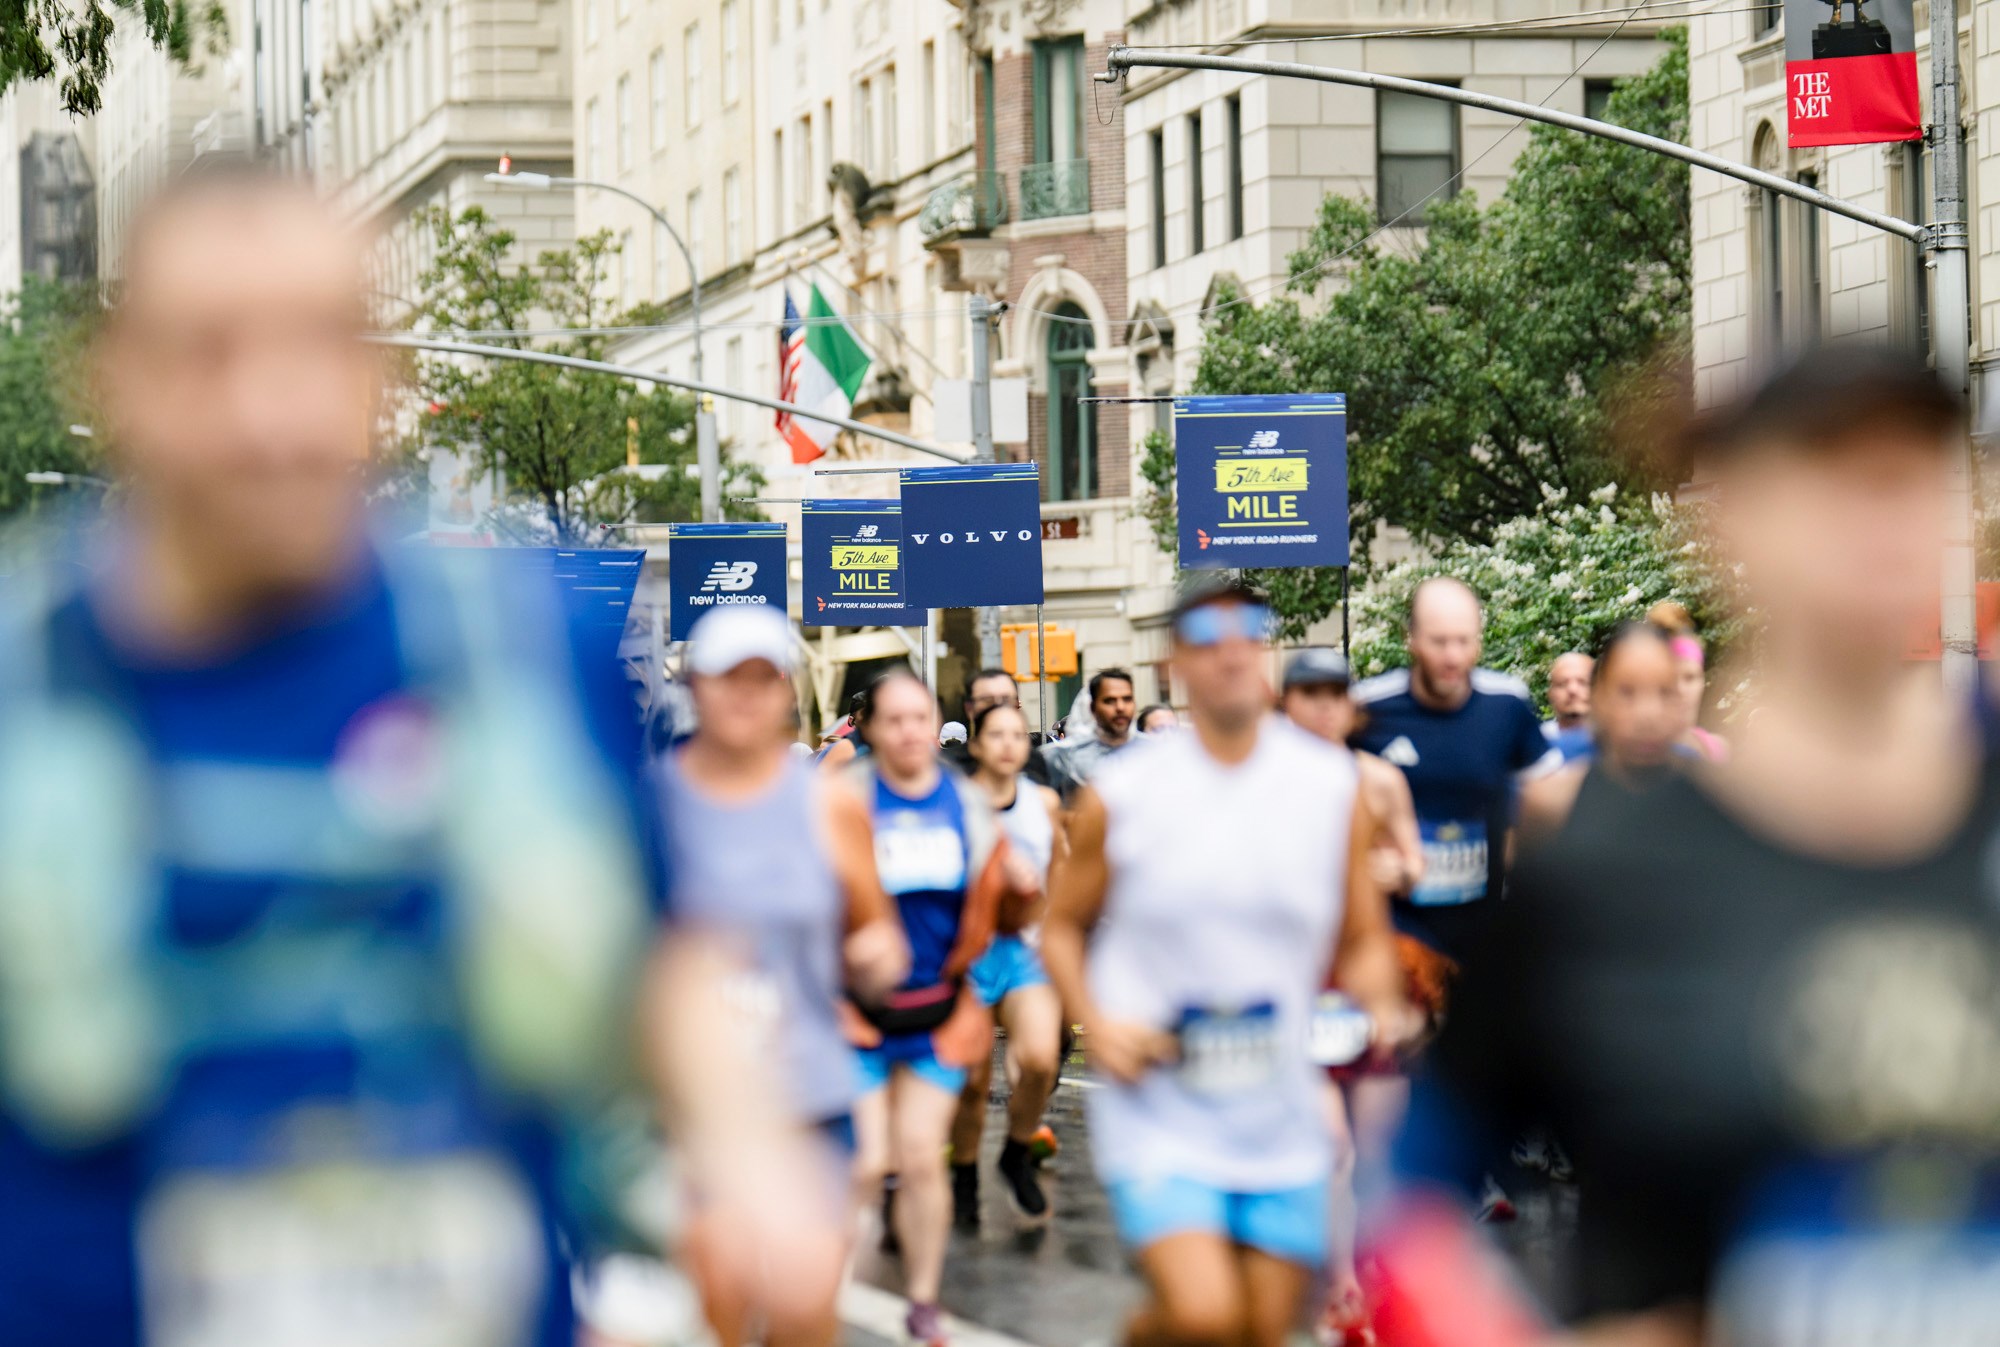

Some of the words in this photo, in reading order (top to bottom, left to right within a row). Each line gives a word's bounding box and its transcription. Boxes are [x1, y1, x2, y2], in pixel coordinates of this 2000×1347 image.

[1793, 71, 1830, 96] THE
[1793, 95, 1832, 119] MET
[1227, 466, 1261, 488] 5th
[1227, 495, 1298, 519] MILE
[911, 530, 1032, 544] VOLVO
[1047, 522, 1061, 539] St
[1212, 537, 1232, 545] NEW
[1233, 536, 1256, 544] YORK
[1256, 536, 1279, 544] ROAD
[1279, 535, 1318, 543] RUNNERS
[839, 551, 864, 566] 5th
[701, 561, 758, 591] NB
[840, 573, 890, 589] MILE
[689, 596, 714, 605] new
[716, 594, 767, 605] balance
